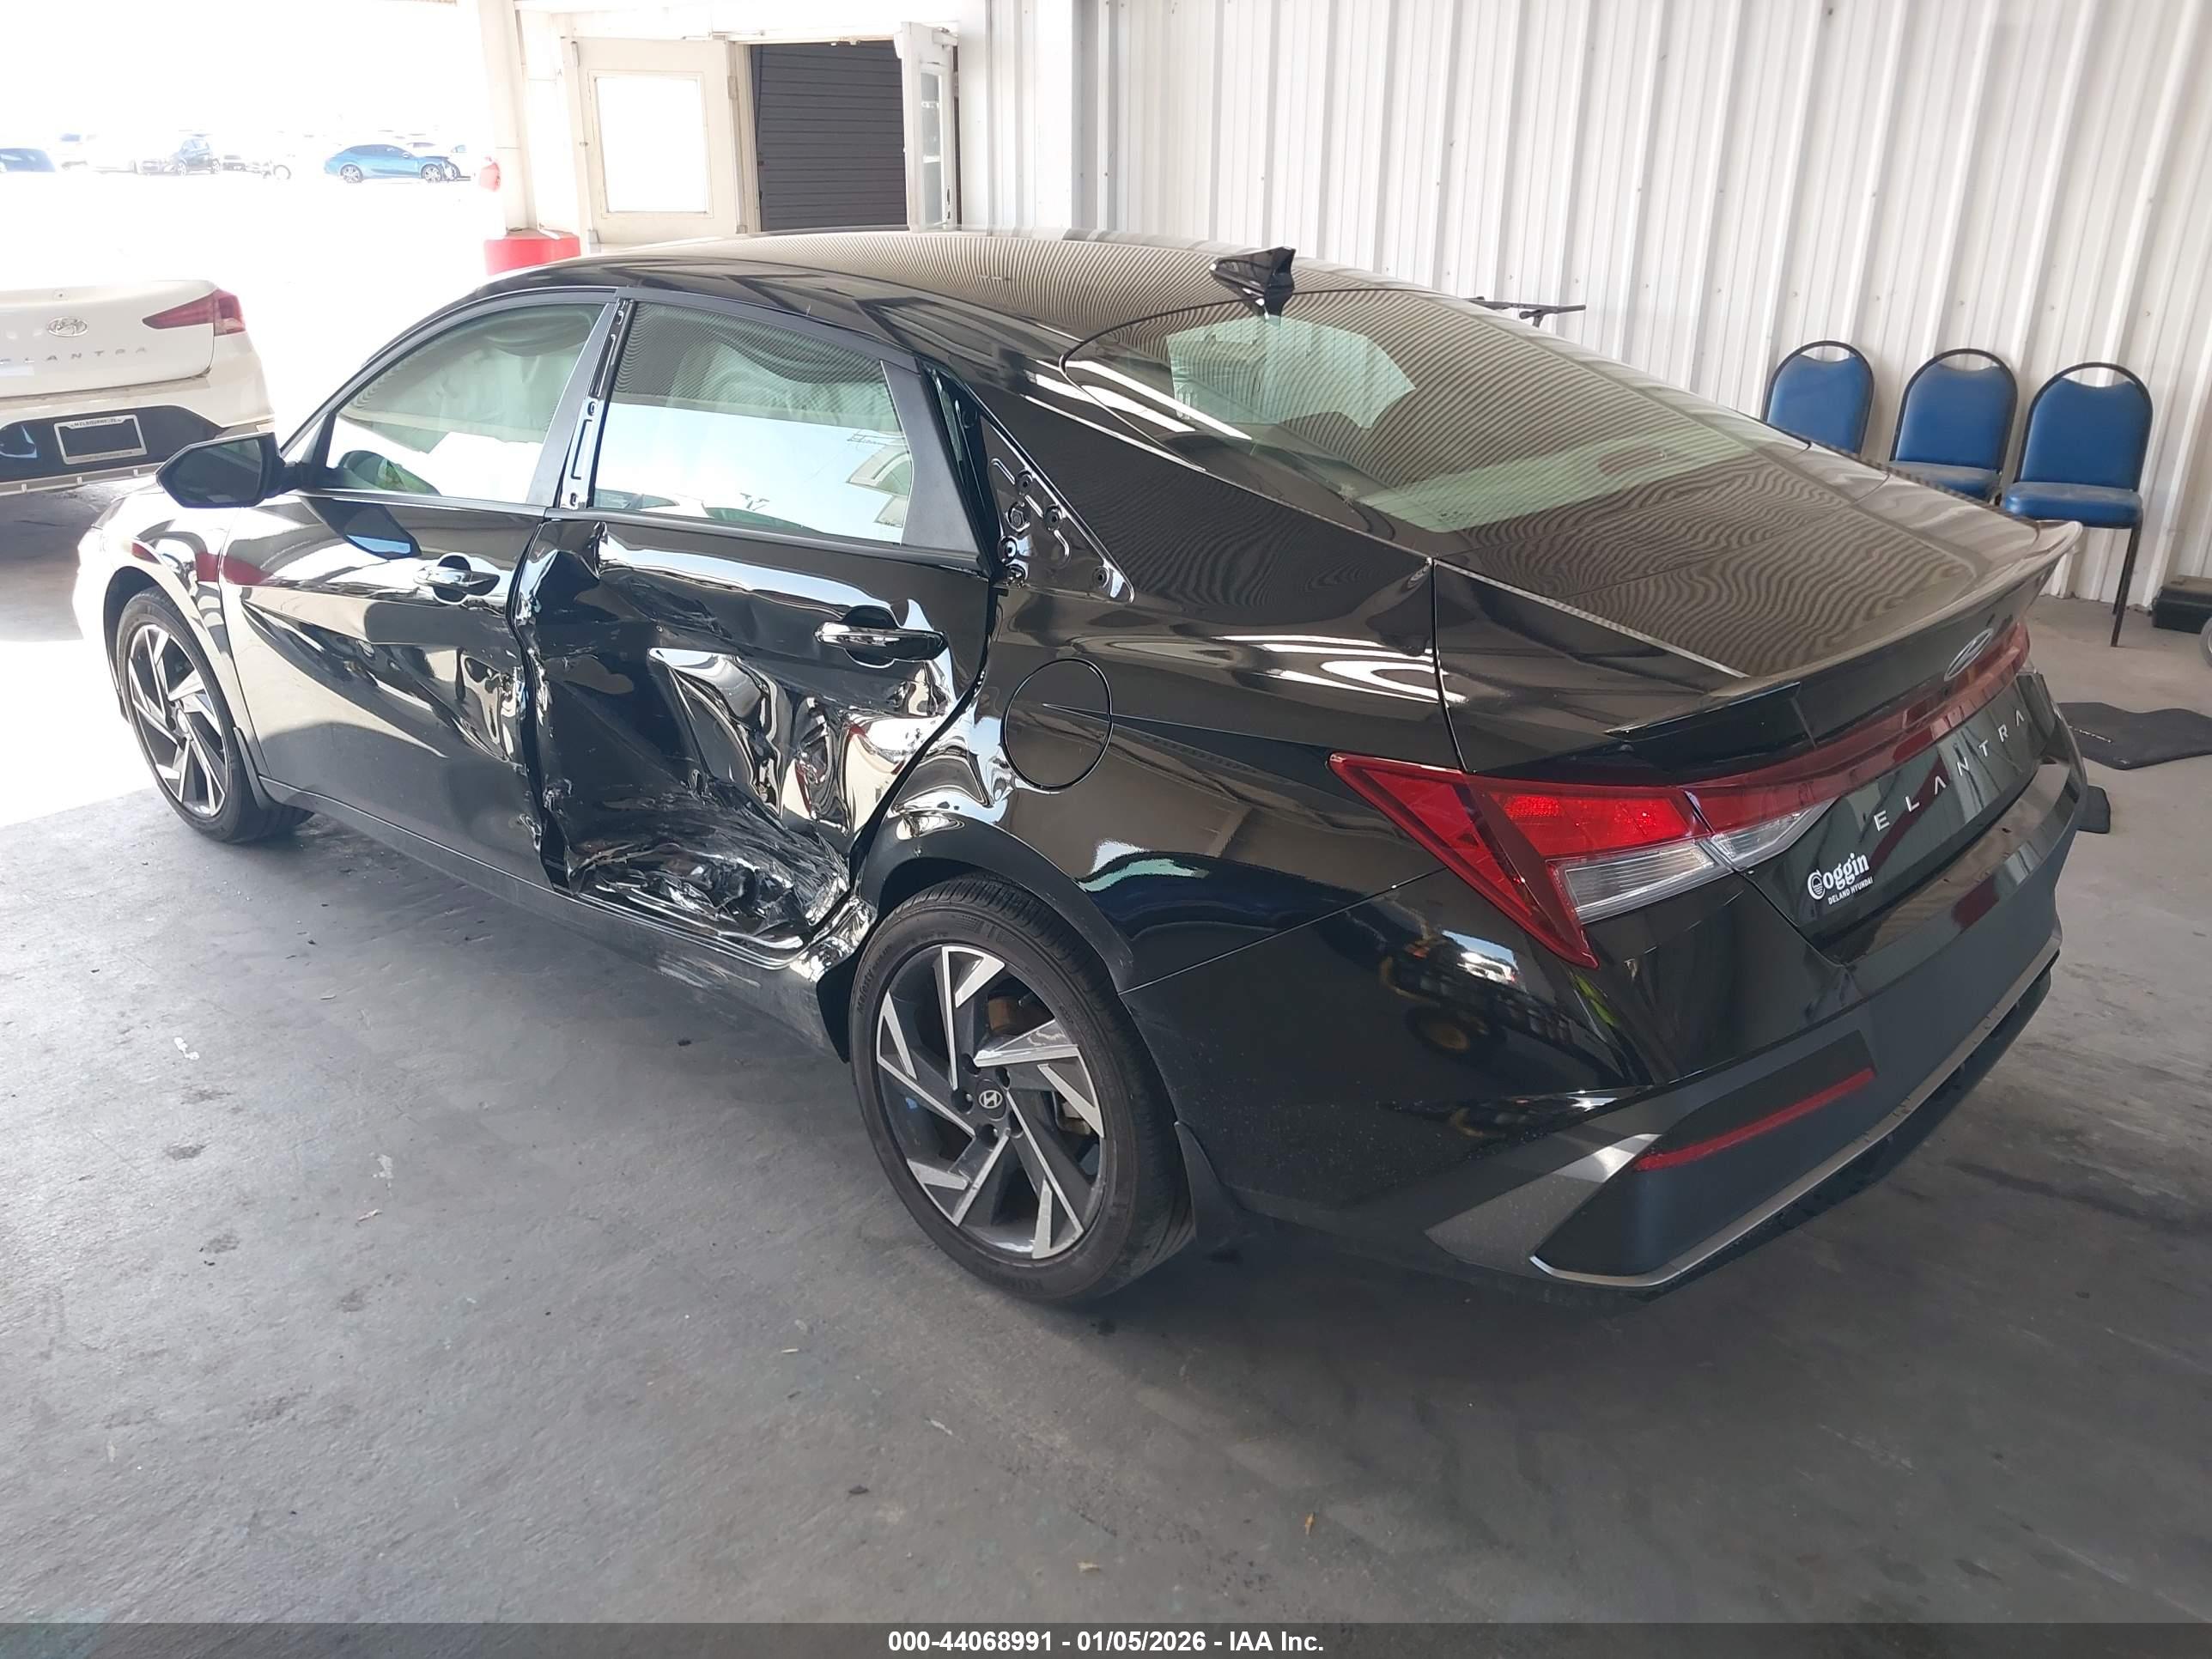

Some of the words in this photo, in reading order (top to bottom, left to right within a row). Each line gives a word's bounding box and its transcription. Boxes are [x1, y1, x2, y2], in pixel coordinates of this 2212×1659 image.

[1874, 709, 2025, 831] ELANTRA
[1808, 853, 1869, 900] Coggin
[1827, 888, 1850, 905] DELAND
[1850, 876, 1874, 894] HYUNDAI
